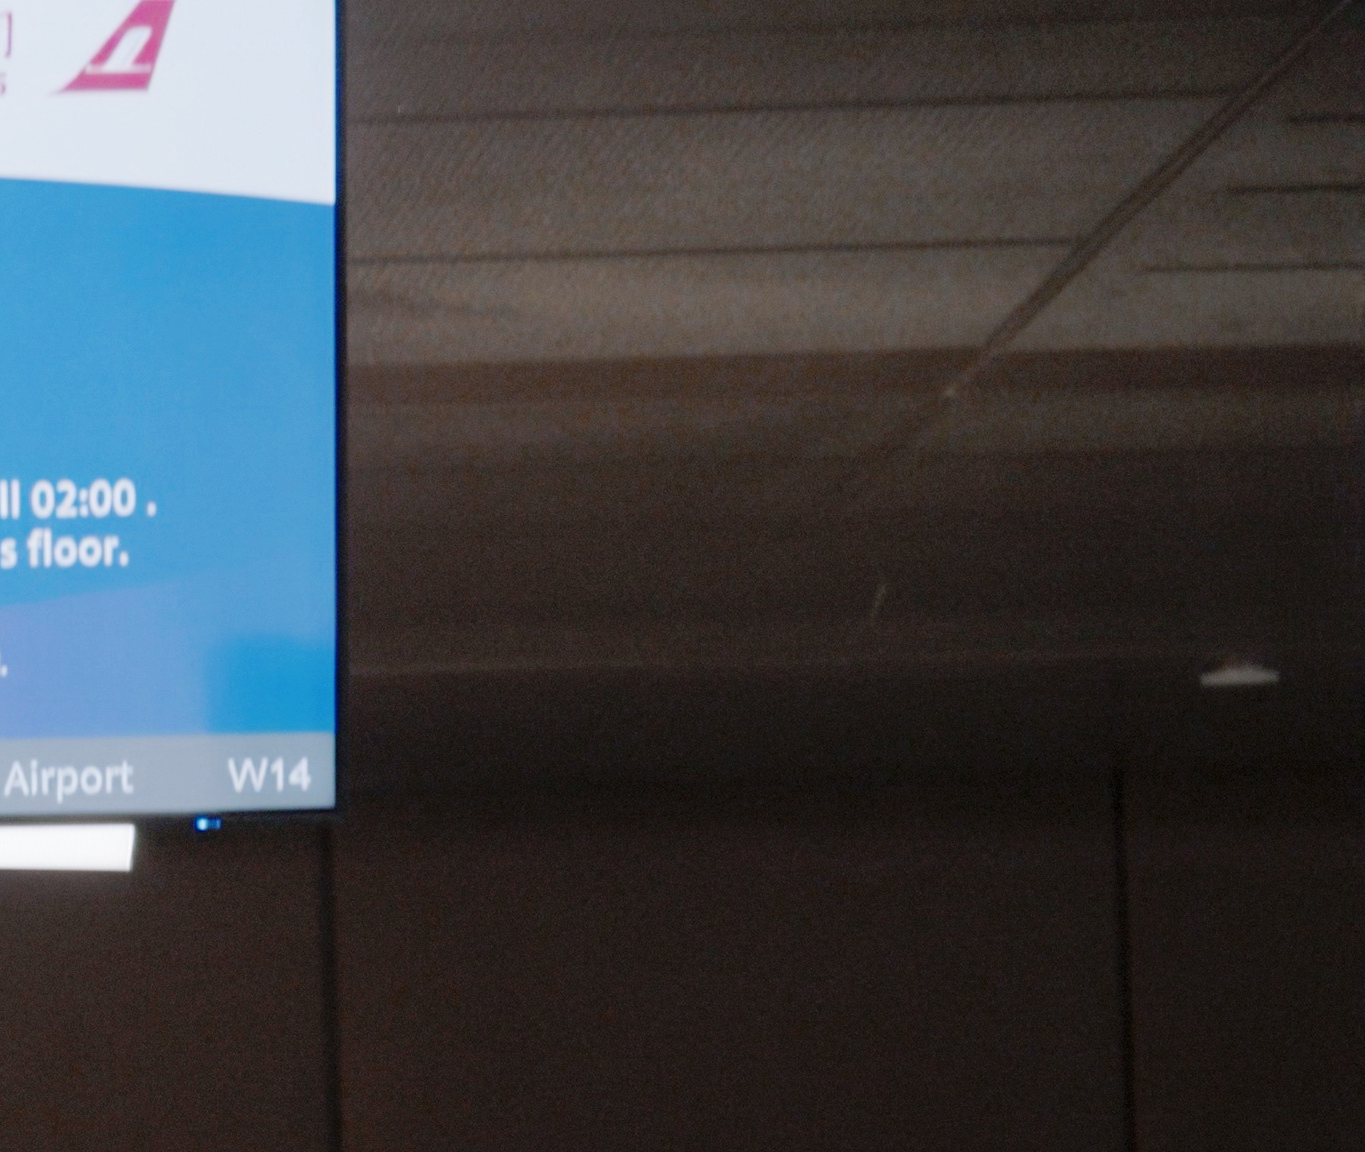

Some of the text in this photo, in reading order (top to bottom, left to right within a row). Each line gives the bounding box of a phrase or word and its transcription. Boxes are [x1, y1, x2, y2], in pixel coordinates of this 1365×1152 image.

[31, 478, 136, 518] 02:00
[28, 529, 129, 568] floor.
[5, 757, 133, 804] Airport
[229, 756, 312, 793] W14
